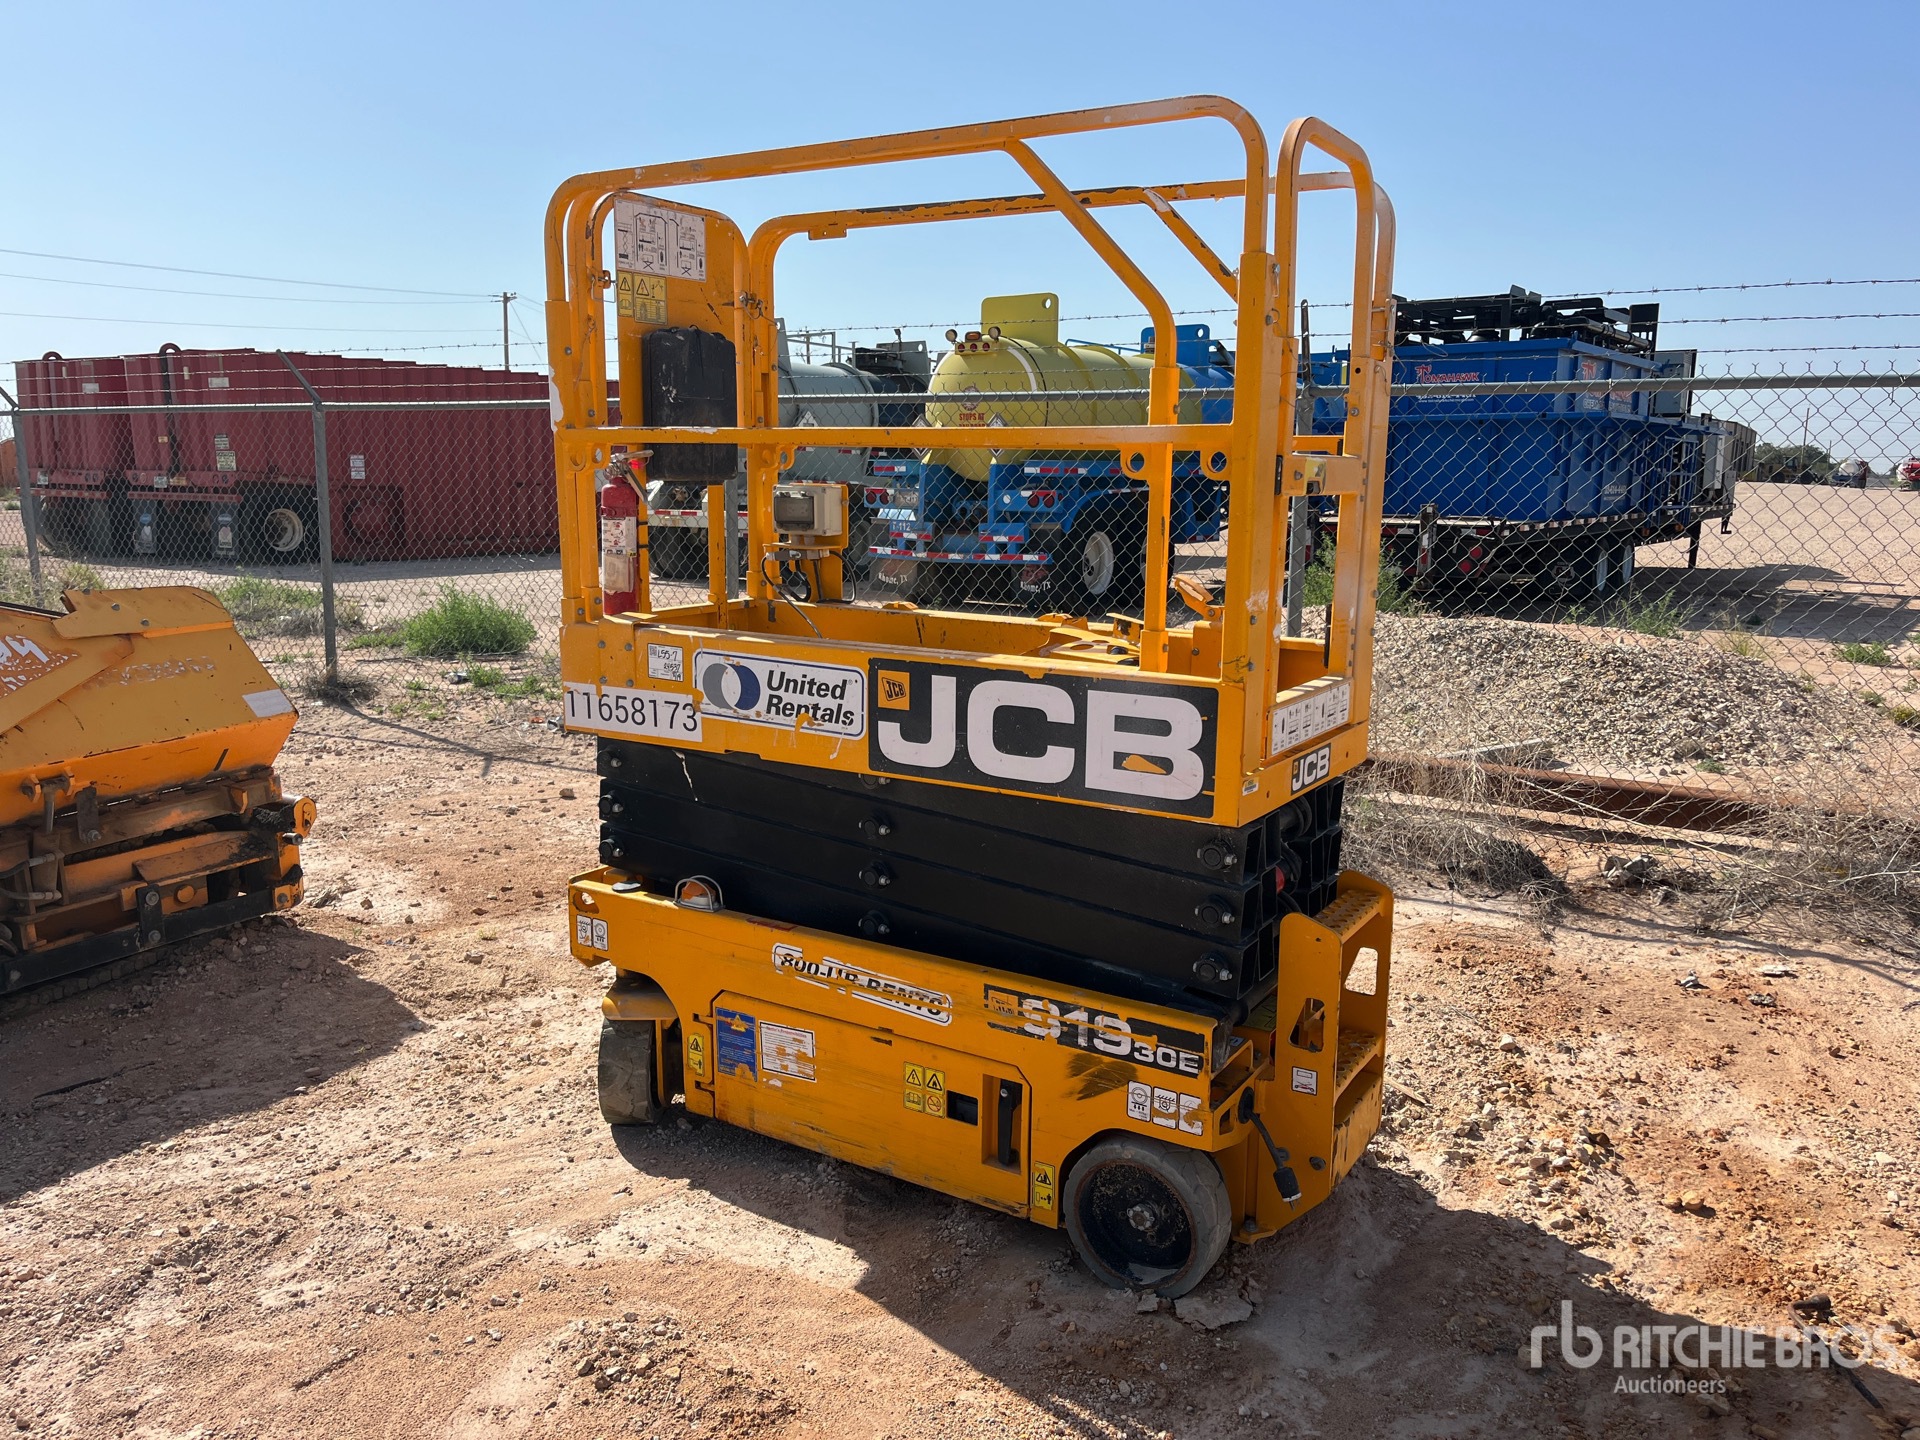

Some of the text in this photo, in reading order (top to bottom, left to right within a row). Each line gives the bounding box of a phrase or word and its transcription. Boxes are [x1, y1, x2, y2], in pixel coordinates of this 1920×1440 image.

[1415, 364, 1480, 384] TOMAHAWK
[959, 412, 977, 421] STOPS
[767, 670, 848, 701] United
[880, 676, 908, 702] JCB
[566, 690, 698, 732] 11658173
[765, 694, 856, 727] Rentals
[877, 674, 1204, 801] JCB
[1292, 747, 1330, 791] JCB
